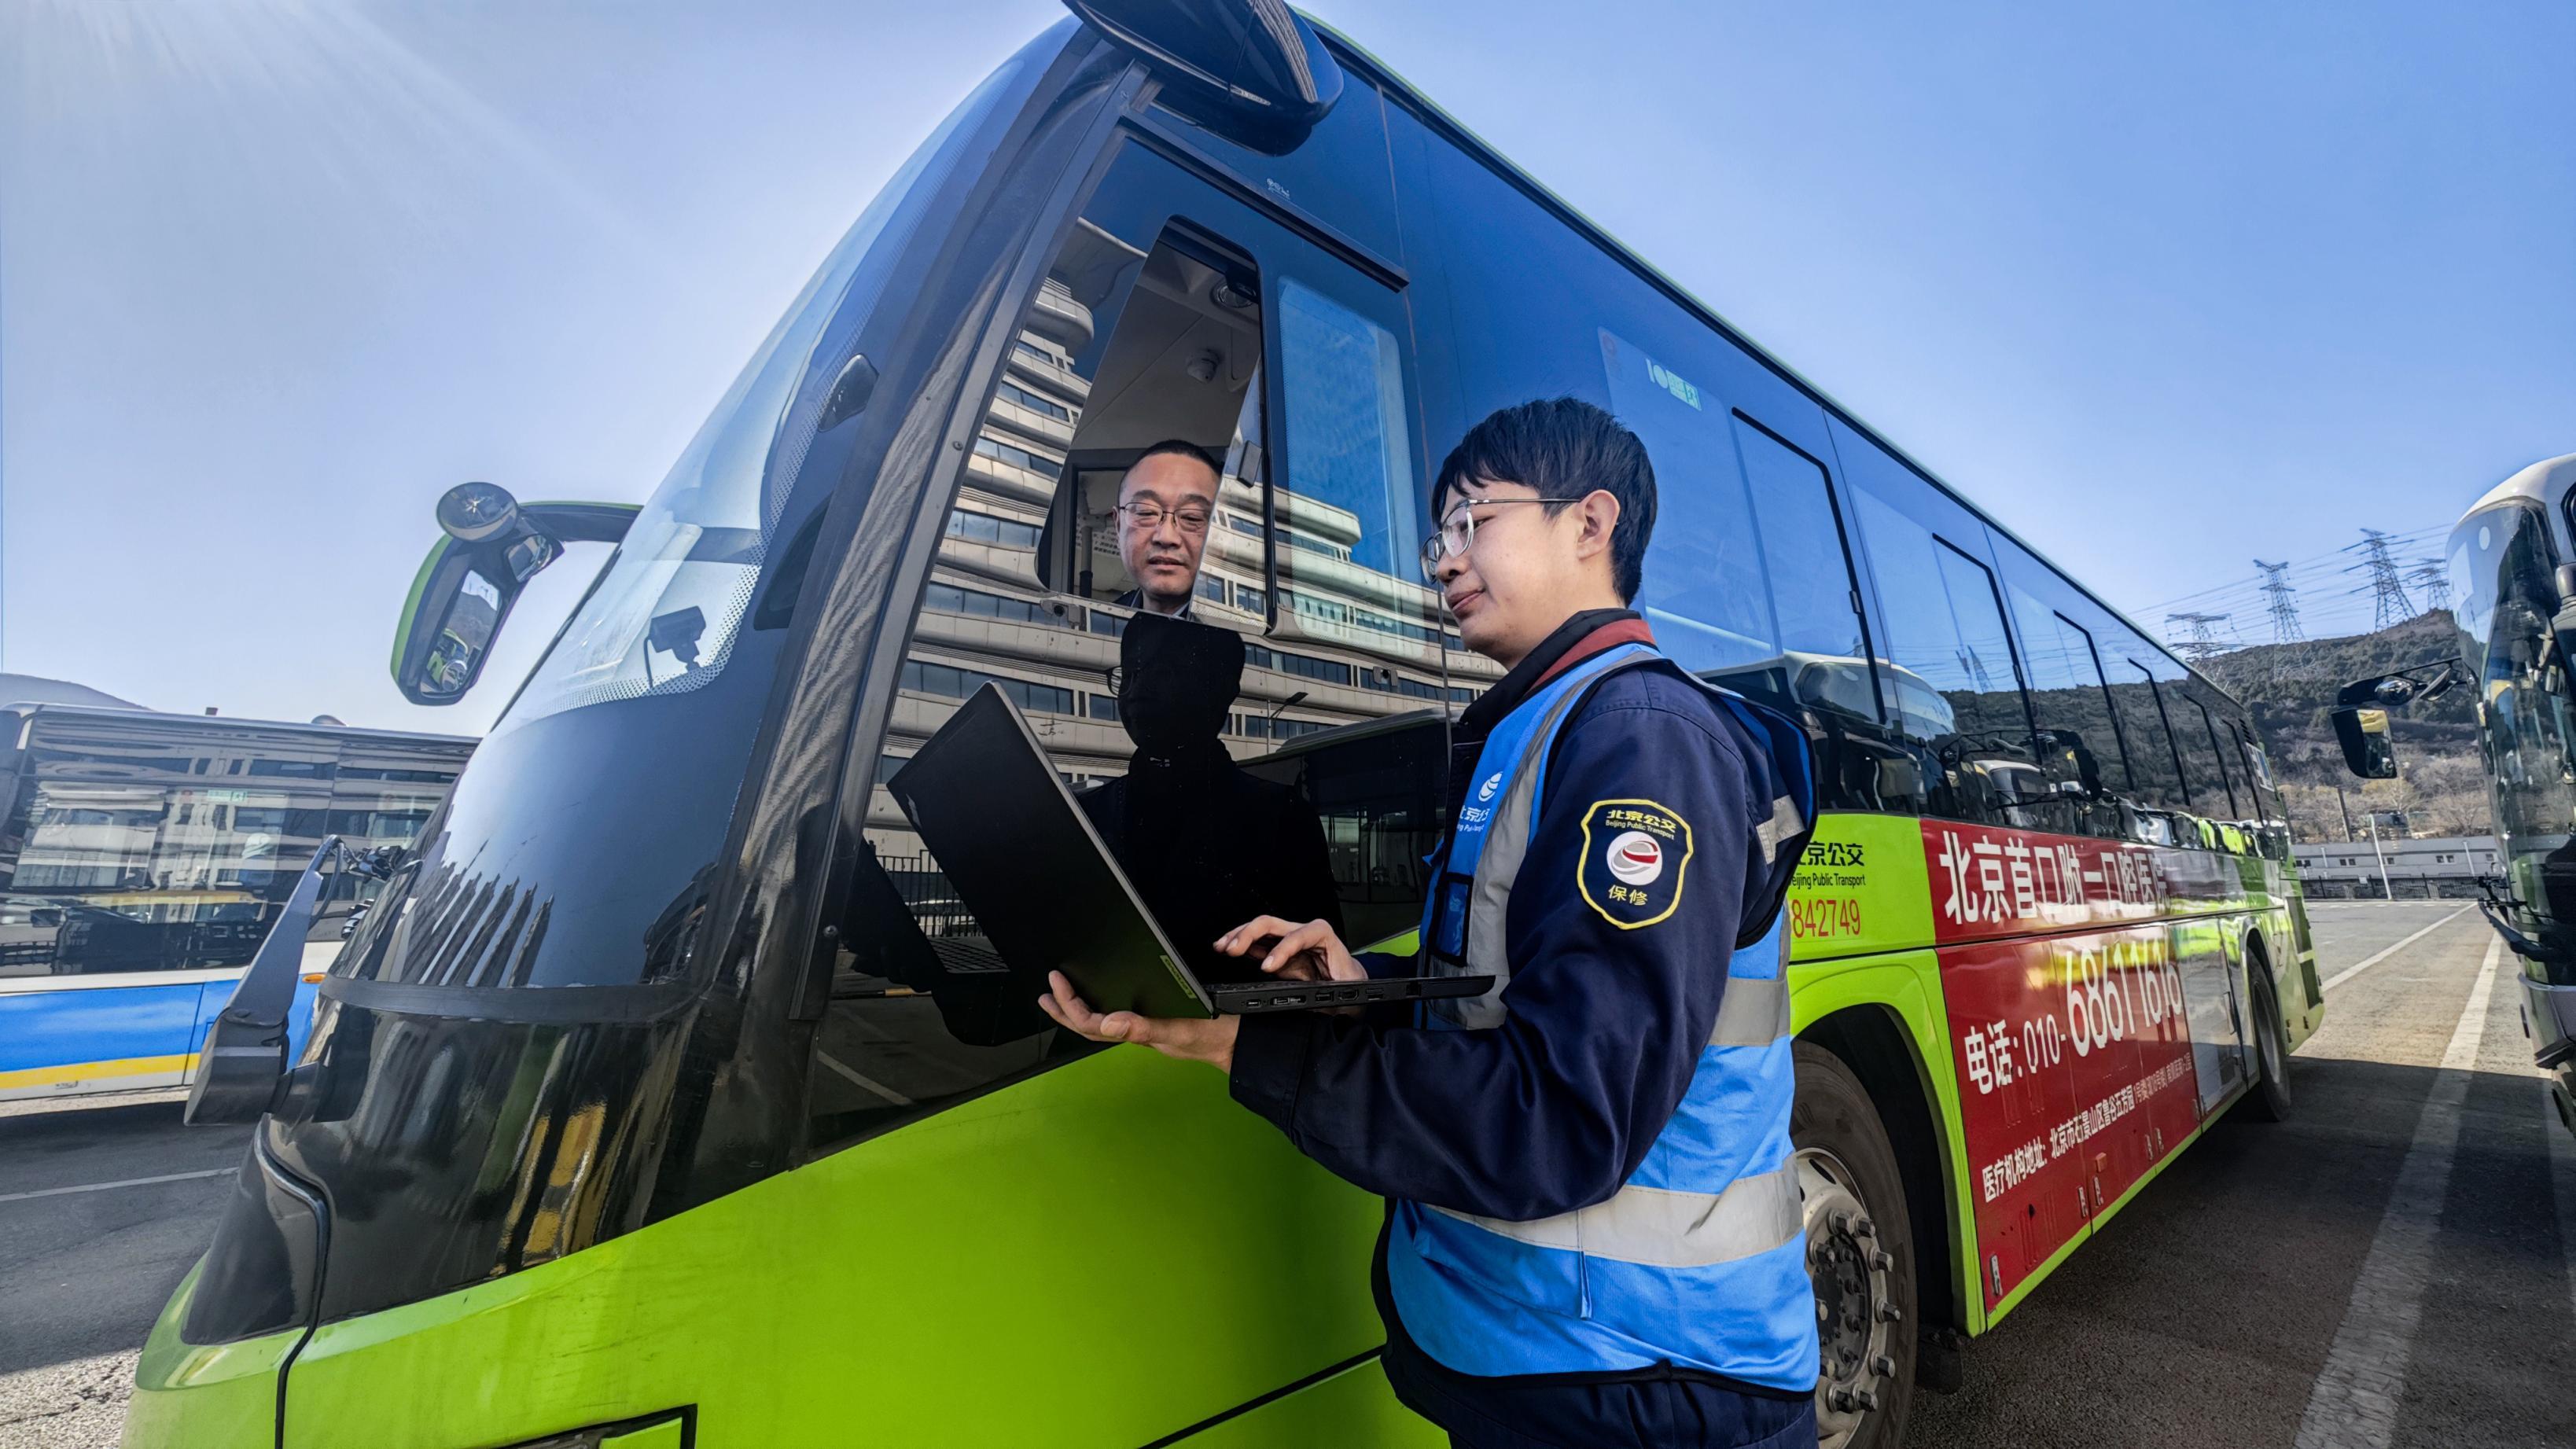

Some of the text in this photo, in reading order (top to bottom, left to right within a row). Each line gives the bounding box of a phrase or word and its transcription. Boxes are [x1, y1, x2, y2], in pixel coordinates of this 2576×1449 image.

[1606, 810, 1676, 833] 北京公交
[1606, 819, 1675, 840] Beijing Public Transport
[1791, 872, 1867, 890] eijing Public Transport
[1608, 884, 1648, 906] 保修
